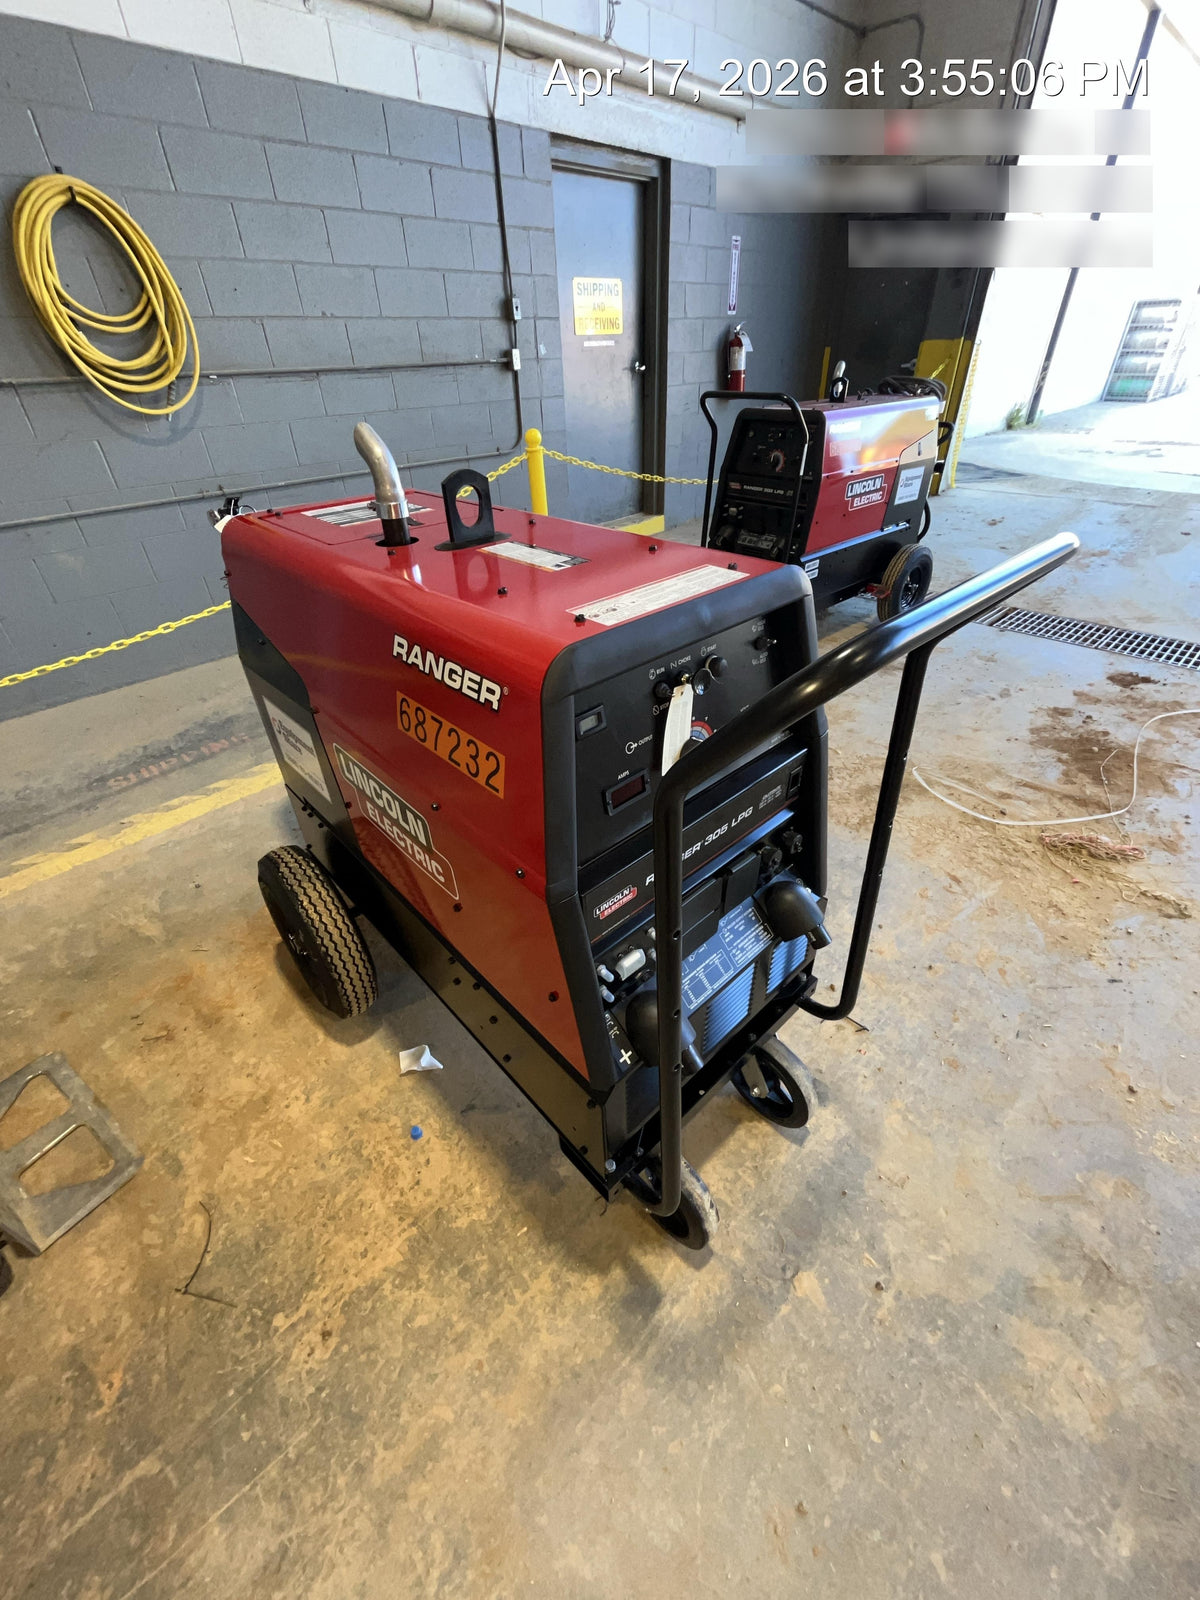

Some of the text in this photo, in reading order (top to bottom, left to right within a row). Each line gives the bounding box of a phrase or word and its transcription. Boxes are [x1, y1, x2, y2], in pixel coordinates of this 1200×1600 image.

[577, 282, 619, 297] SHIPPING
[847, 477, 882, 498] LINCOLN
[853, 491, 883, 507] ELECTRIC
[391, 633, 502, 711] RANGER
[399, 697, 501, 794] 687232
[617, 769, 630, 781] AMPS
[338, 752, 427, 847] LINCOLN
[365, 800, 446, 883] ELECTRIC
[704, 823, 729, 845] 305
[731, 805, 754, 827] LPG
[596, 887, 631, 915] LINCOLN
